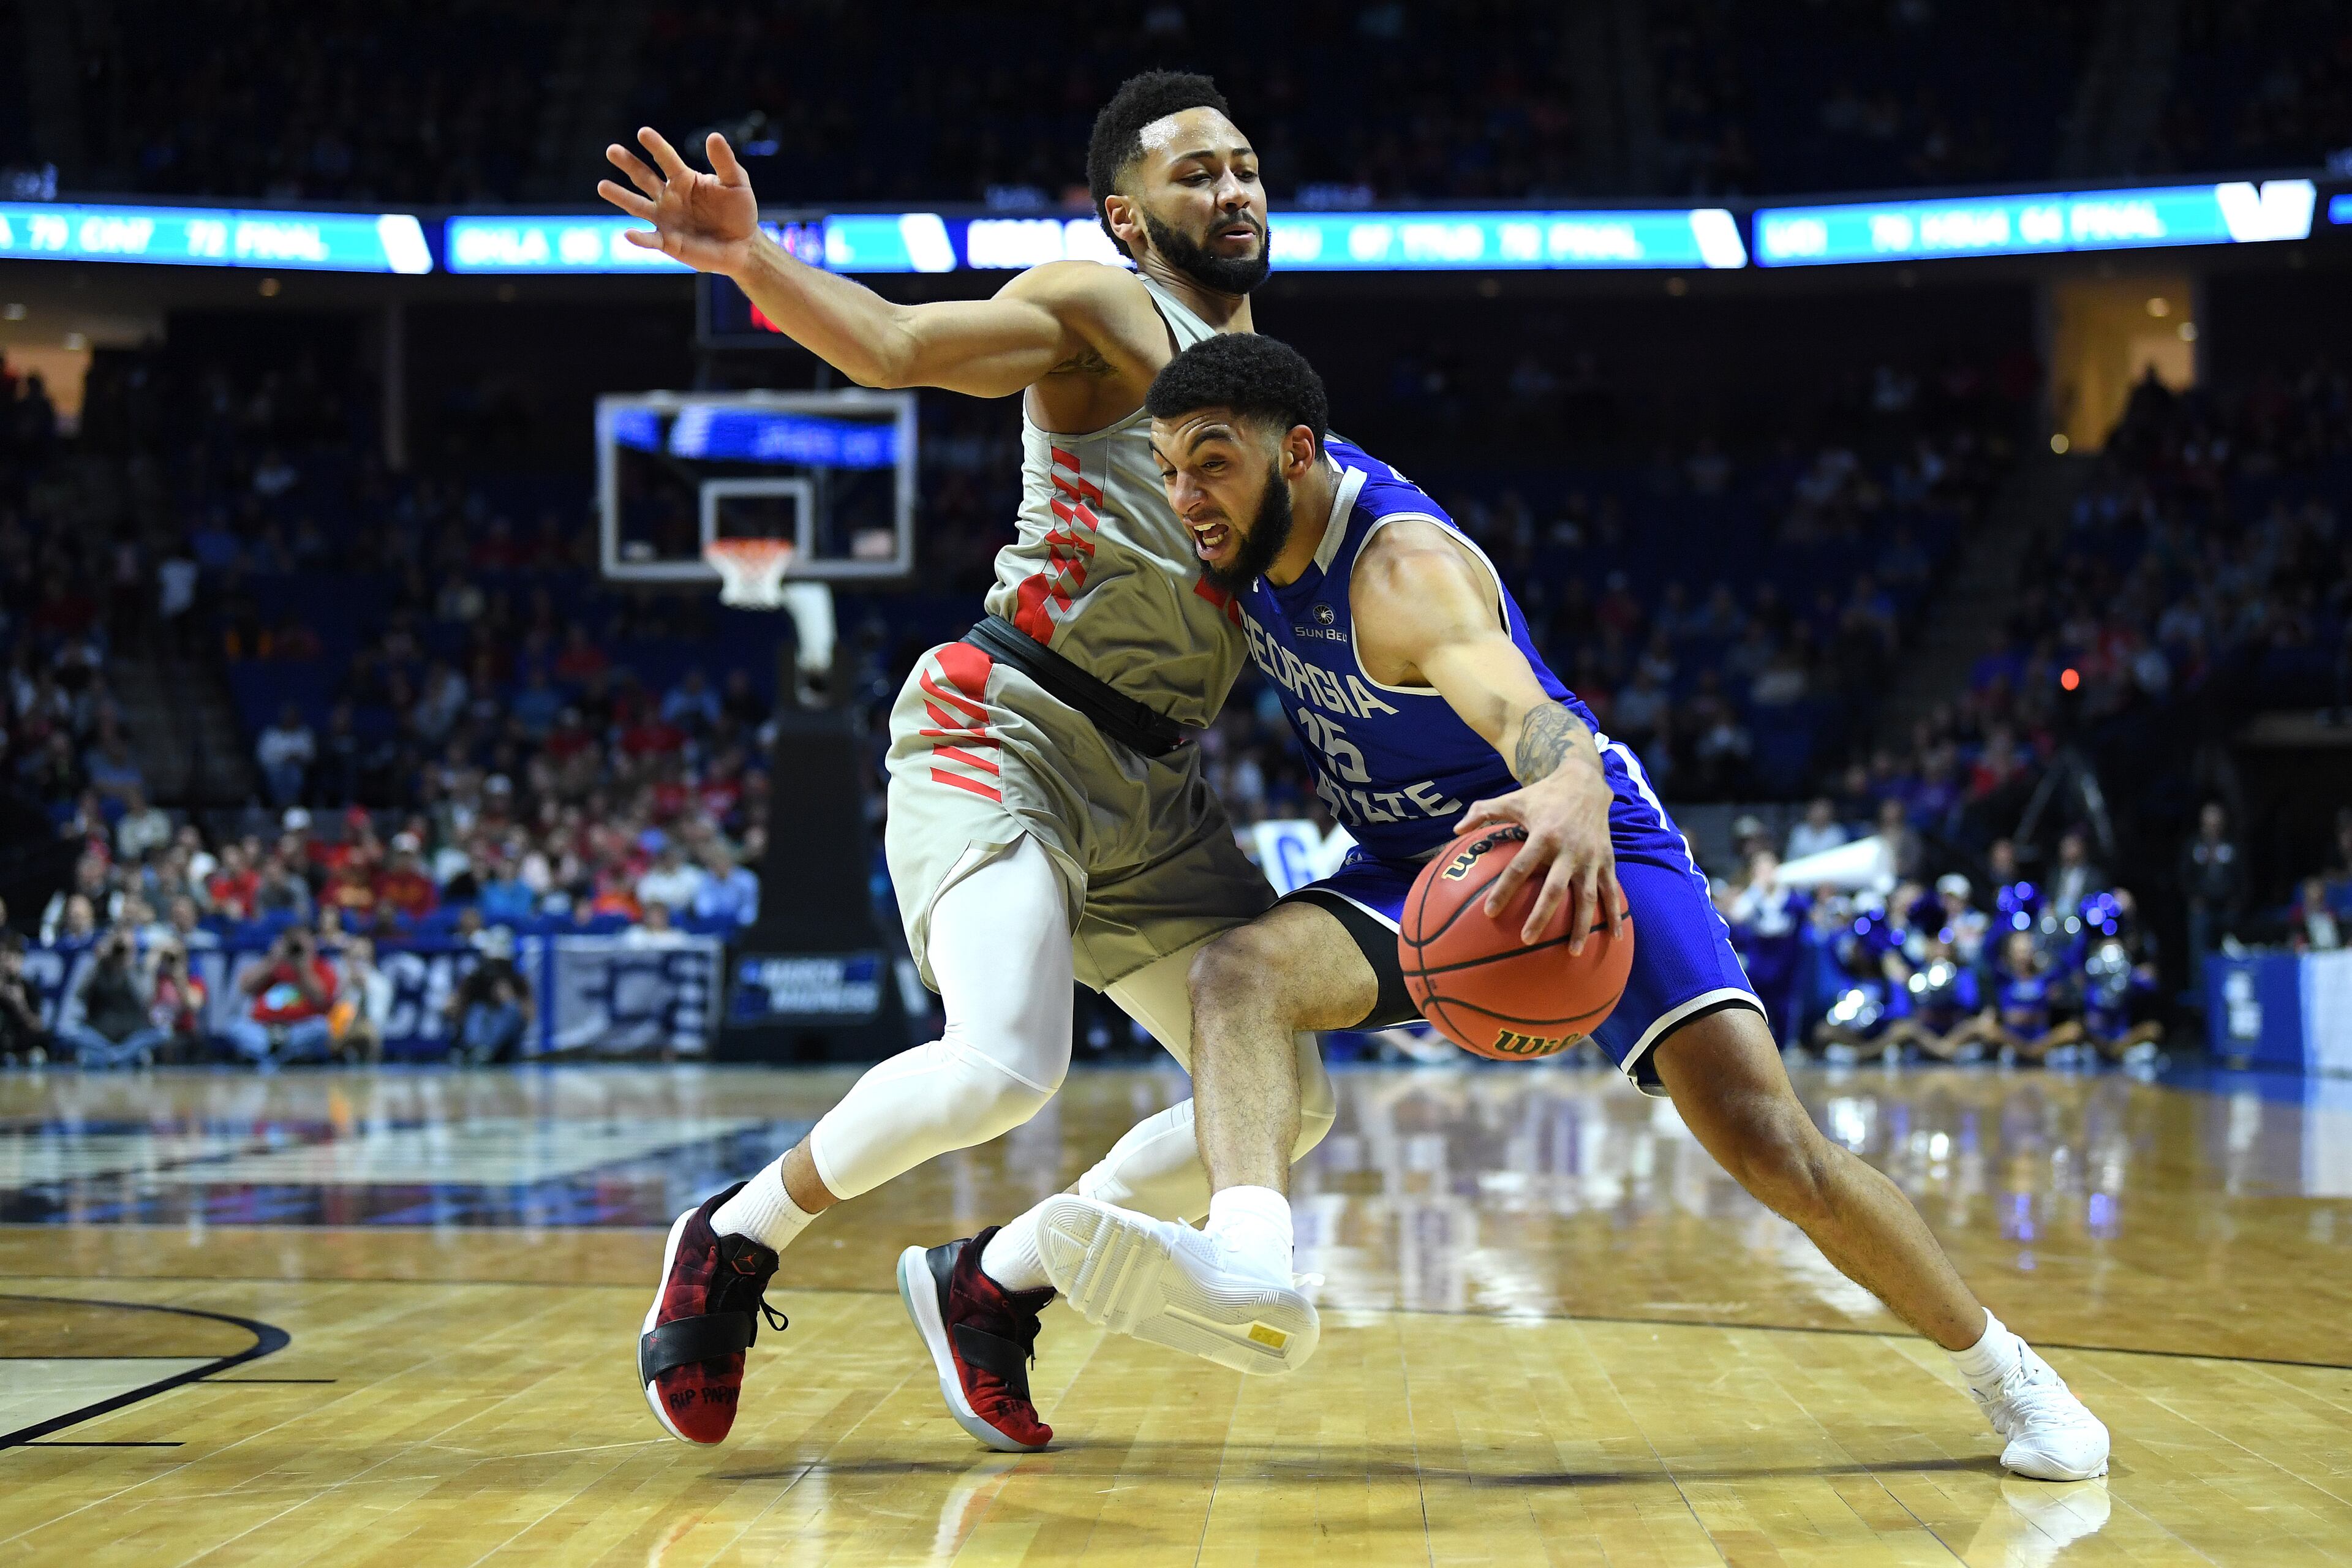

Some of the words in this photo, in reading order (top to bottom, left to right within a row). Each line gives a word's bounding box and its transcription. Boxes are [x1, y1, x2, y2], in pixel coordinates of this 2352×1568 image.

[1237, 600, 1400, 719] GEORGIA
[1295, 627, 1323, 638] SUN
[1297, 706, 1372, 783] 15
[1317, 767, 1463, 826] STATE
[669, 1388, 696, 1411] RIP
